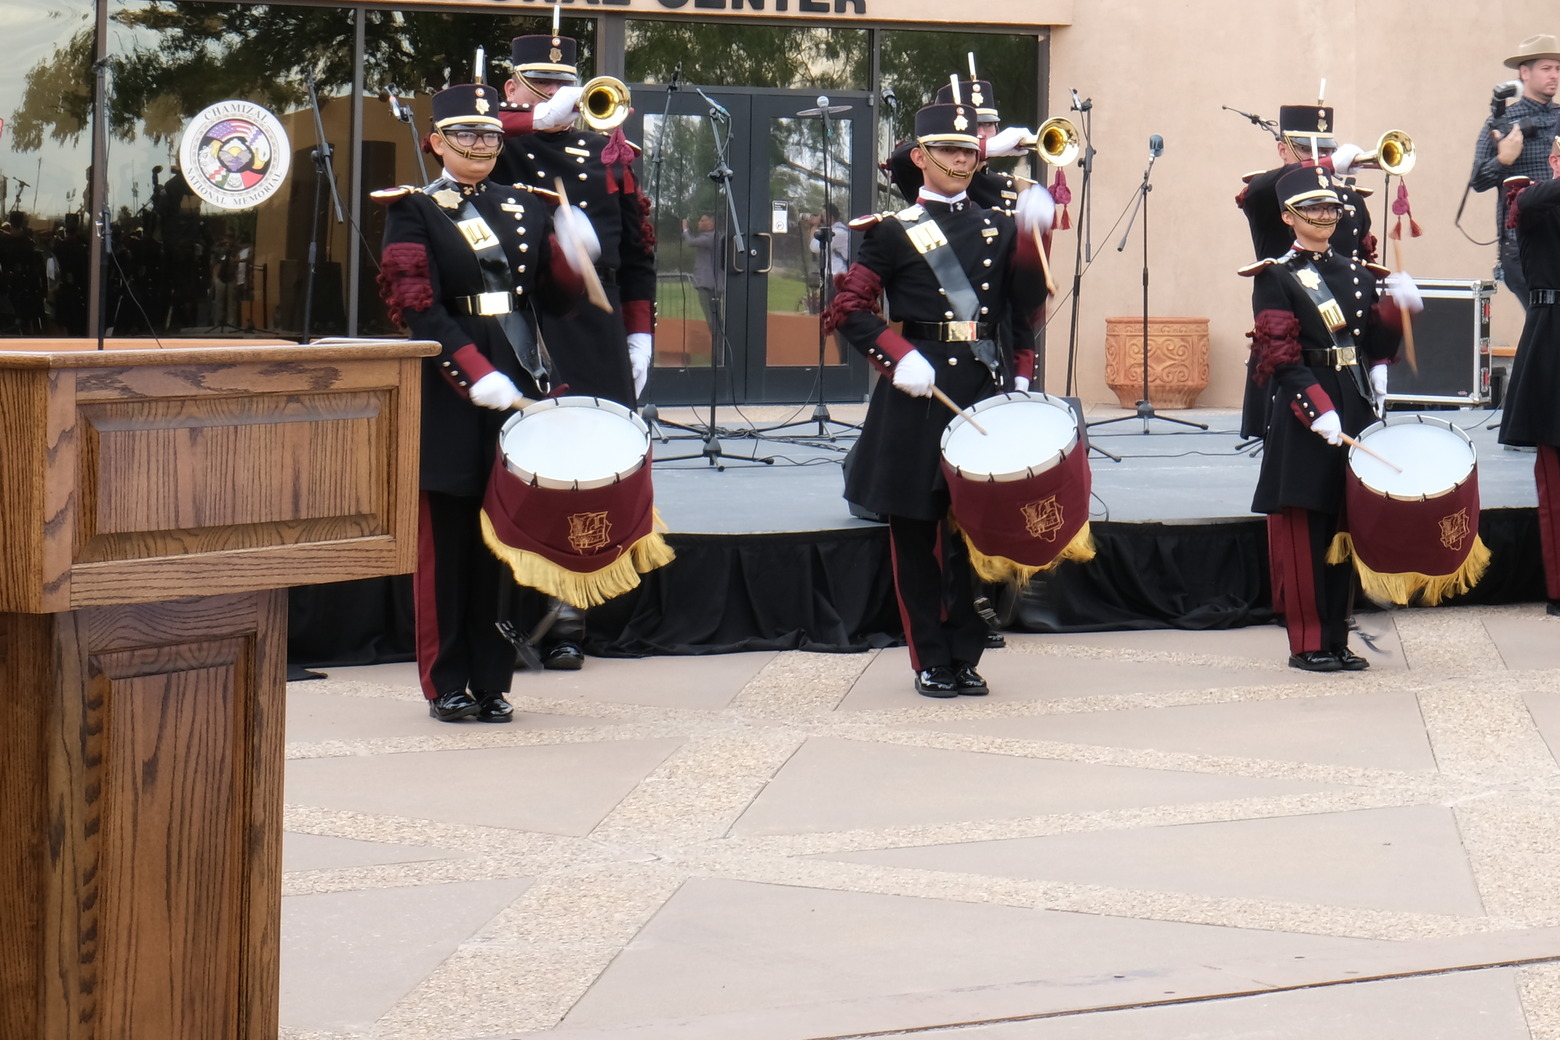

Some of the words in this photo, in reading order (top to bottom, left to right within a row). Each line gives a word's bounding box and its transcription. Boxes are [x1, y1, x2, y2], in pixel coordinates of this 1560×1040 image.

[204, 103, 268, 125] CHAMIZAL
[186, 167, 227, 205] NATIONAL
[233, 171, 283, 206] MEMORIAL
